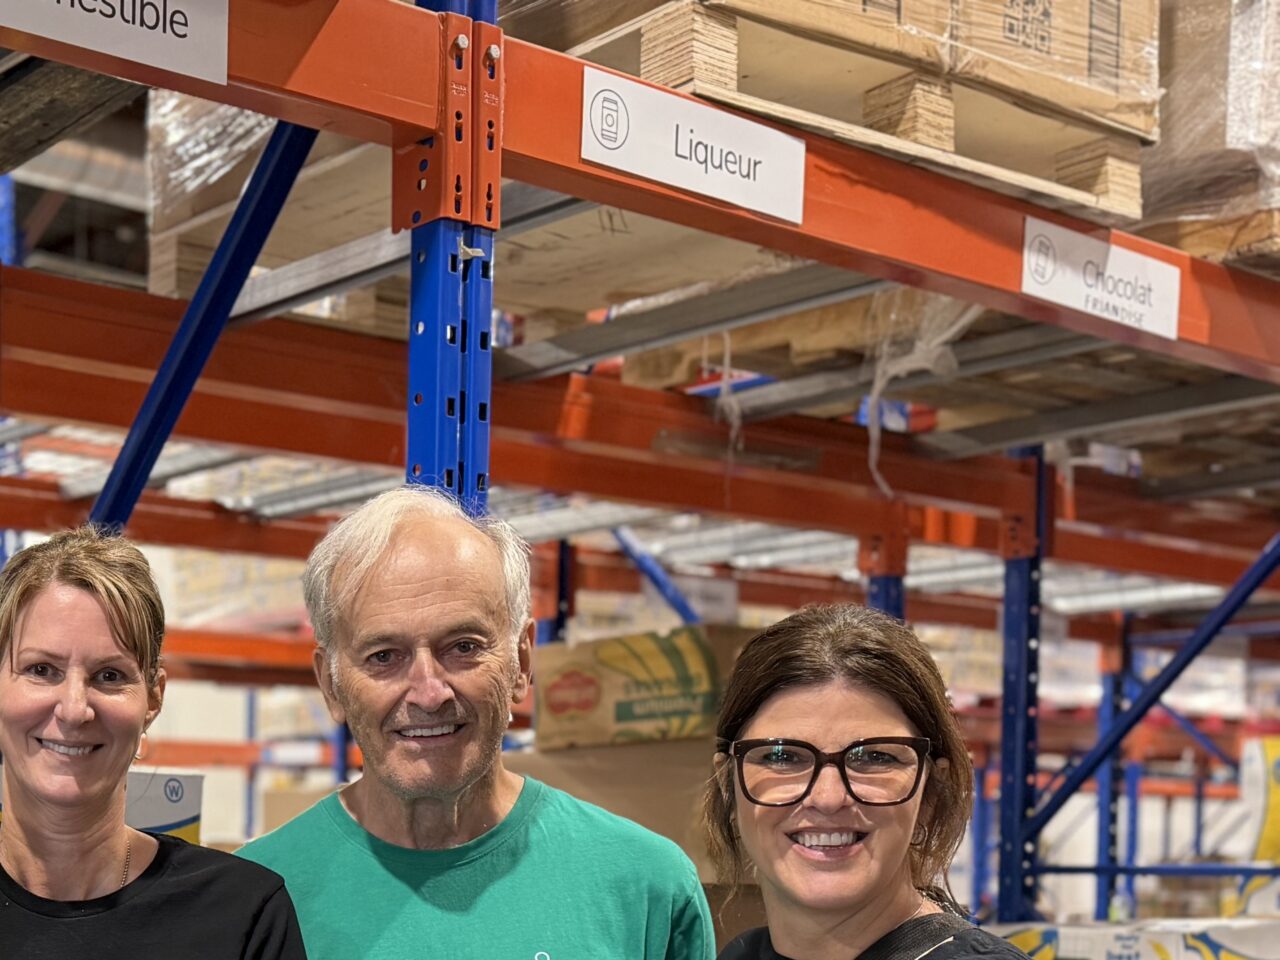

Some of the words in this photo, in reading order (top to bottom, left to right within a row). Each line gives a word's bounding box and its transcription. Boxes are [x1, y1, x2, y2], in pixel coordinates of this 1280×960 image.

[57, 0, 188, 38] stible
[675, 124, 762, 181] Liqueur
[1083, 260, 1152, 307] Chocolat
